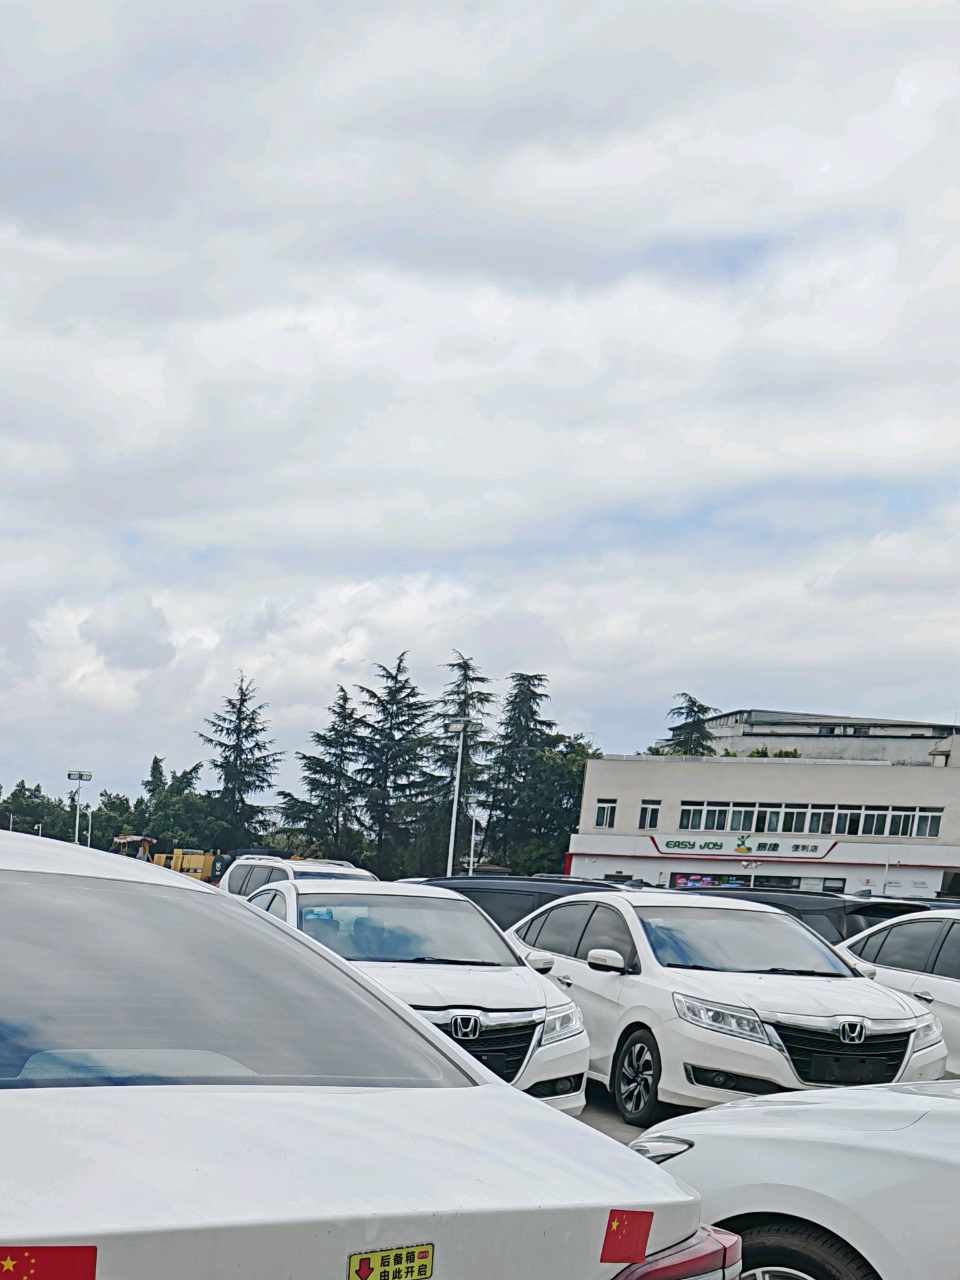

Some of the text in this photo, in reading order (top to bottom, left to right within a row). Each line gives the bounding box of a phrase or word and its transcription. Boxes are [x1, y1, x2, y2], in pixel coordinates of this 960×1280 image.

[665, 840, 723, 850] EASY JOY
[381, 1250, 416, 1267] 后备箱
